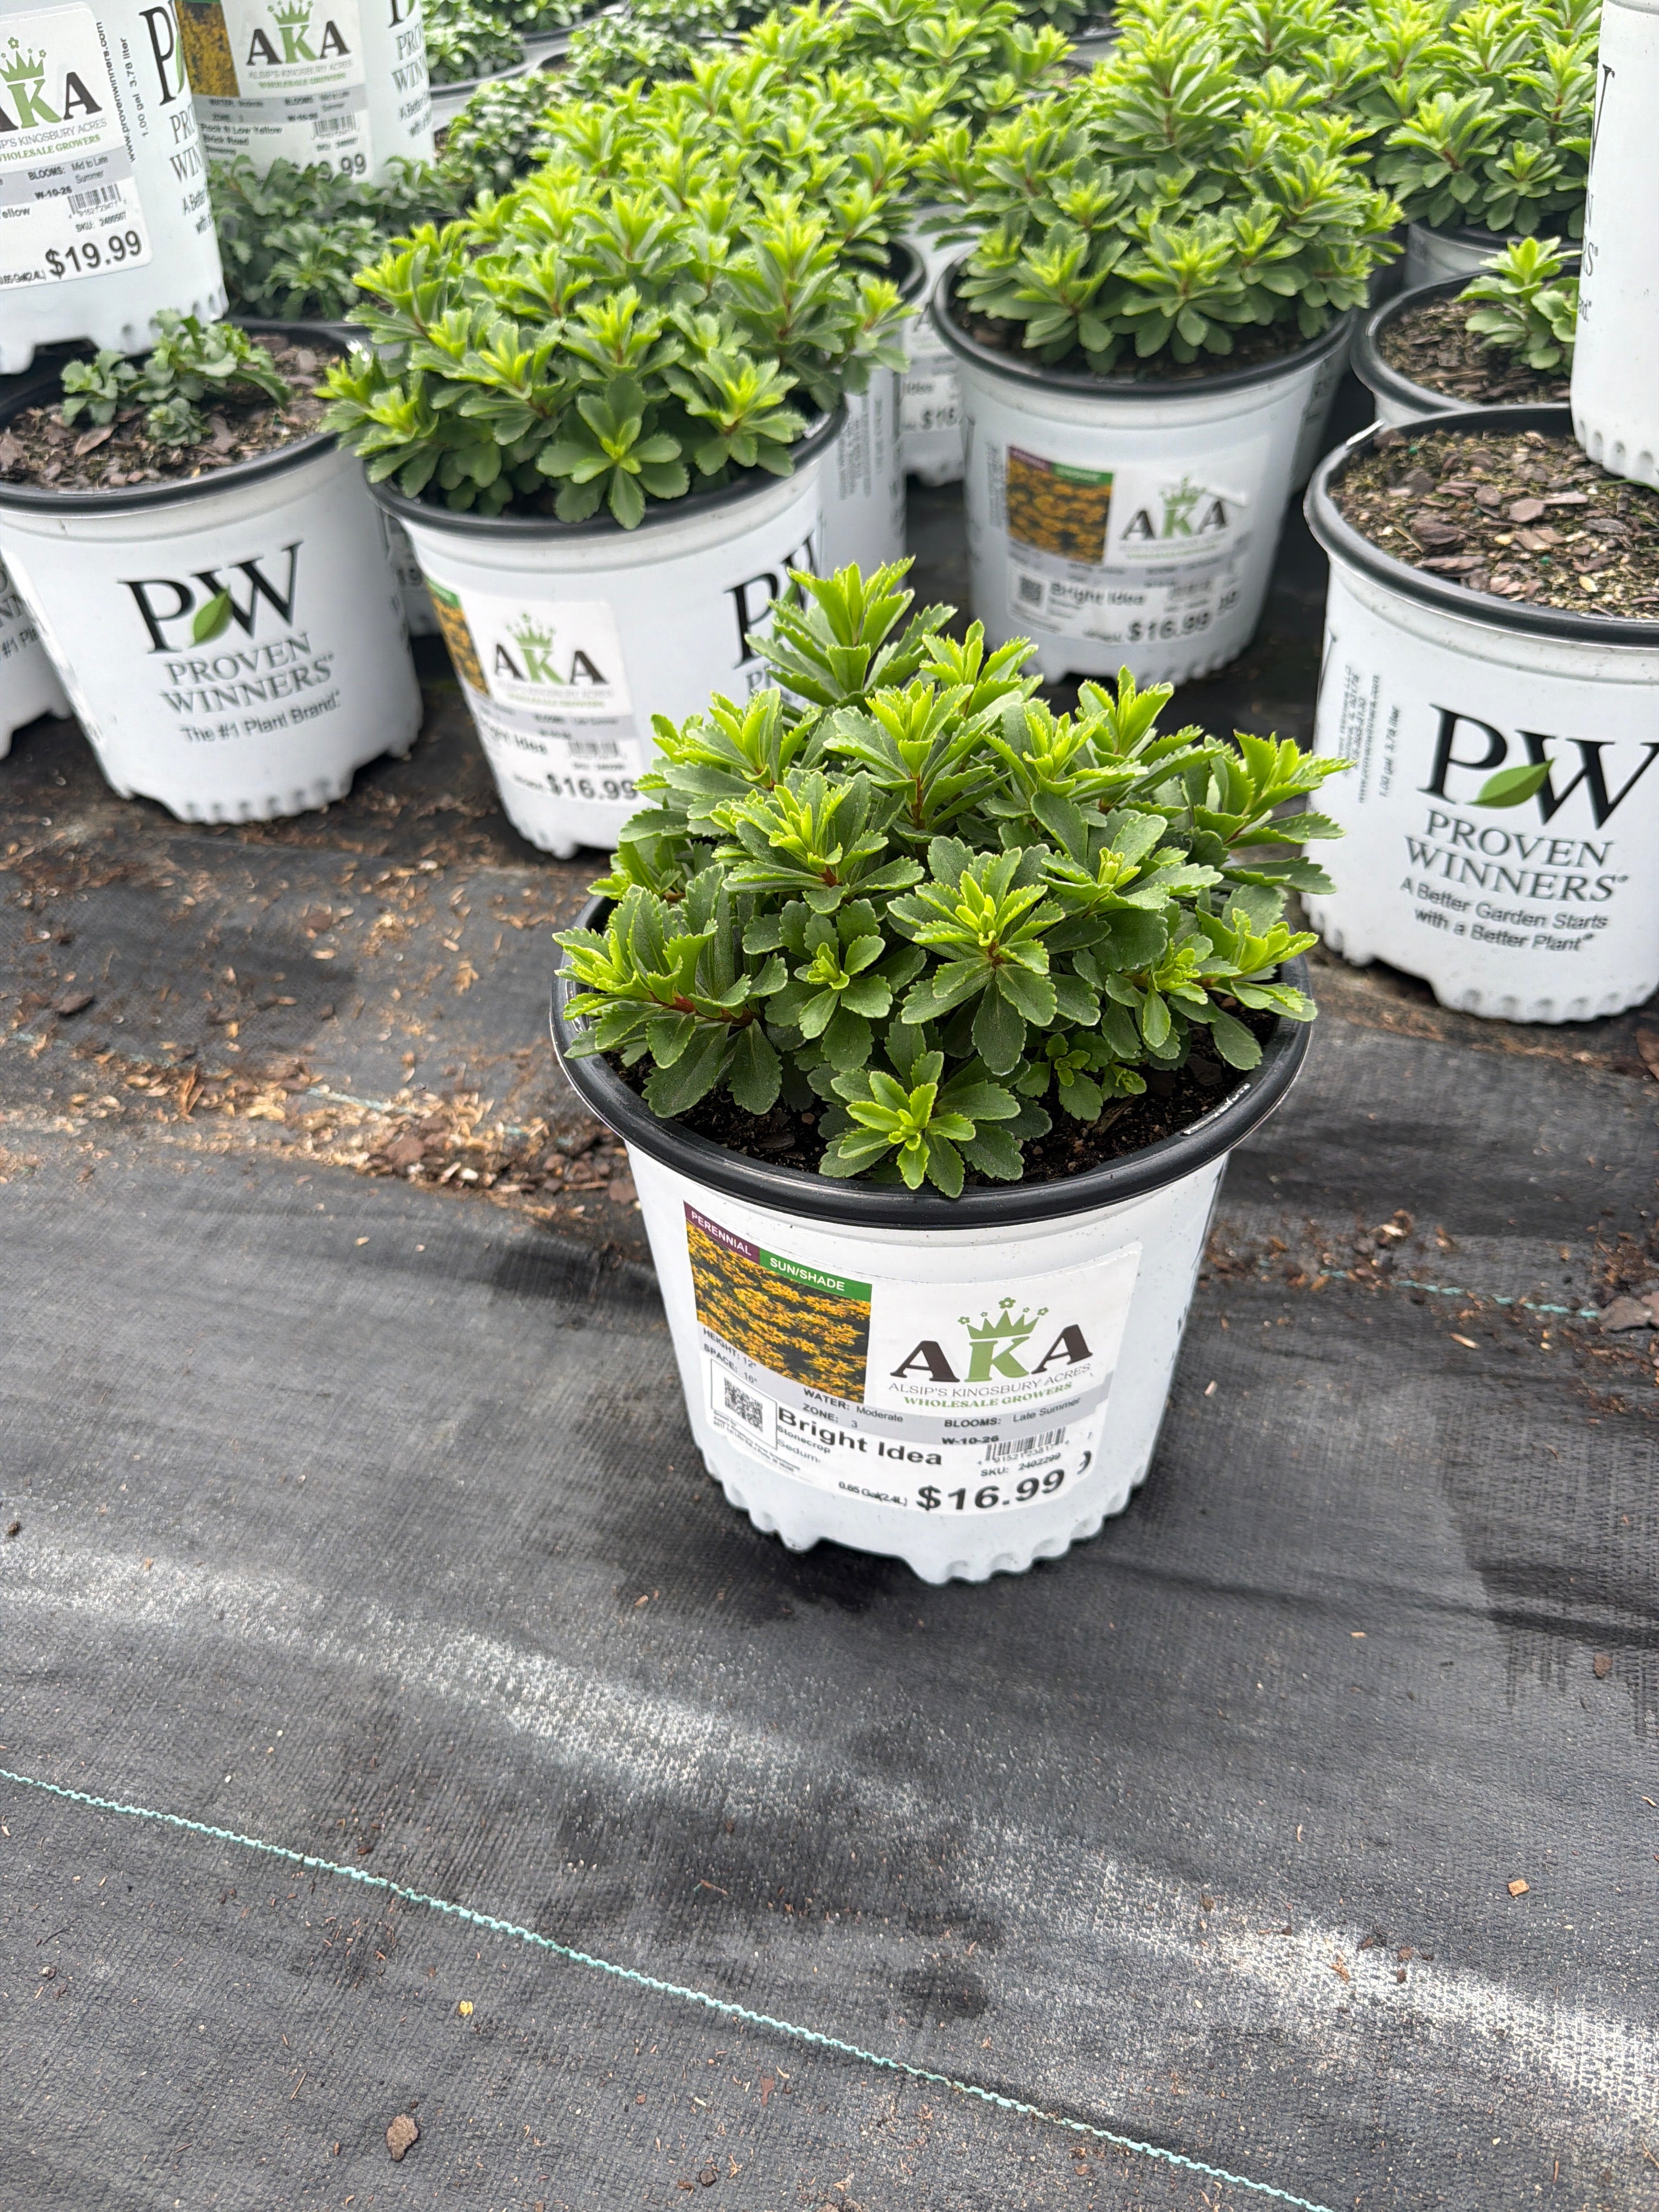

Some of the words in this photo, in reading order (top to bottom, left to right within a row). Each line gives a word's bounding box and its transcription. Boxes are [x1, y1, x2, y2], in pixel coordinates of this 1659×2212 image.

[120, 37, 131, 59] liter
[246, 20, 351, 66] AKA
[96, 21, 136, 163] www.provenwinners.com
[132, 93, 144, 111] gal
[19, 126, 75, 146] KINGSBURY
[78, 118, 108, 133] ACRES
[56, 134, 100, 151] GROWERS
[0, 207, 30, 219] ellow
[45, 230, 143, 279] $19.99
[1119, 500, 1228, 540] AKA
[117, 540, 303, 654] PW
[163, 631, 311, 686] PROVEN
[494, 644, 611, 686] AKA
[180, 724, 216, 742] The
[218, 722, 239, 740] #1
[245, 711, 287, 736] Plant
[1416, 703, 1659, 830] PW
[546, 773, 638, 800] $16.99
[1424, 809, 1616, 868] PROVEN
[1400, 877, 1413, 893] A
[1417, 882, 1471, 912] Better
[1476, 900, 1547, 928] Garden
[1552, 911, 1609, 930] Starts
[1414, 907, 1449, 930] with
[1453, 922, 1465, 935] a
[1470, 923, 1528, 948] Better
[691, 1210, 752, 1256] PERENNIAL
[770, 1257, 845, 1292] SUN/SHADE
[703, 1327, 740, 1360] HEIGHT:
[743, 1356, 757, 1369] 12"
[704, 1344, 737, 1373] SPACE:
[743, 1372, 758, 1384] 16"
[890, 1323, 1093, 1383] AKA
[888, 1383, 947, 1397] ALSIP'S
[952, 1380, 1041, 1397] KINGSBURY
[1044, 1363, 1091, 1386] ACRES
[904, 1396, 998, 1408] WHOLESALE
[1002, 1381, 1073, 1405] GROWERS
[803, 1403, 839, 1423] ZONE:
[851, 1419, 857, 1428] 3
[804, 1387, 850, 1410] WATER:
[856, 1406, 904, 1422] Moderate
[944, 1418, 1002, 1428] BLOOMS:
[1013, 1410, 1036, 1423] Late
[1039, 1397, 1081, 1417] Summer
[777, 1425, 831, 1454] Stonecrop
[778, 1406, 867, 1453] Bright
[878, 1441, 943, 1465] Idea
[941, 1435, 999, 1445] W-10-26
[838, 1481, 860, 1494] 0.65
[916, 1468, 1065, 1511] $16.99
[980, 1466, 1009, 1477] SKU:
